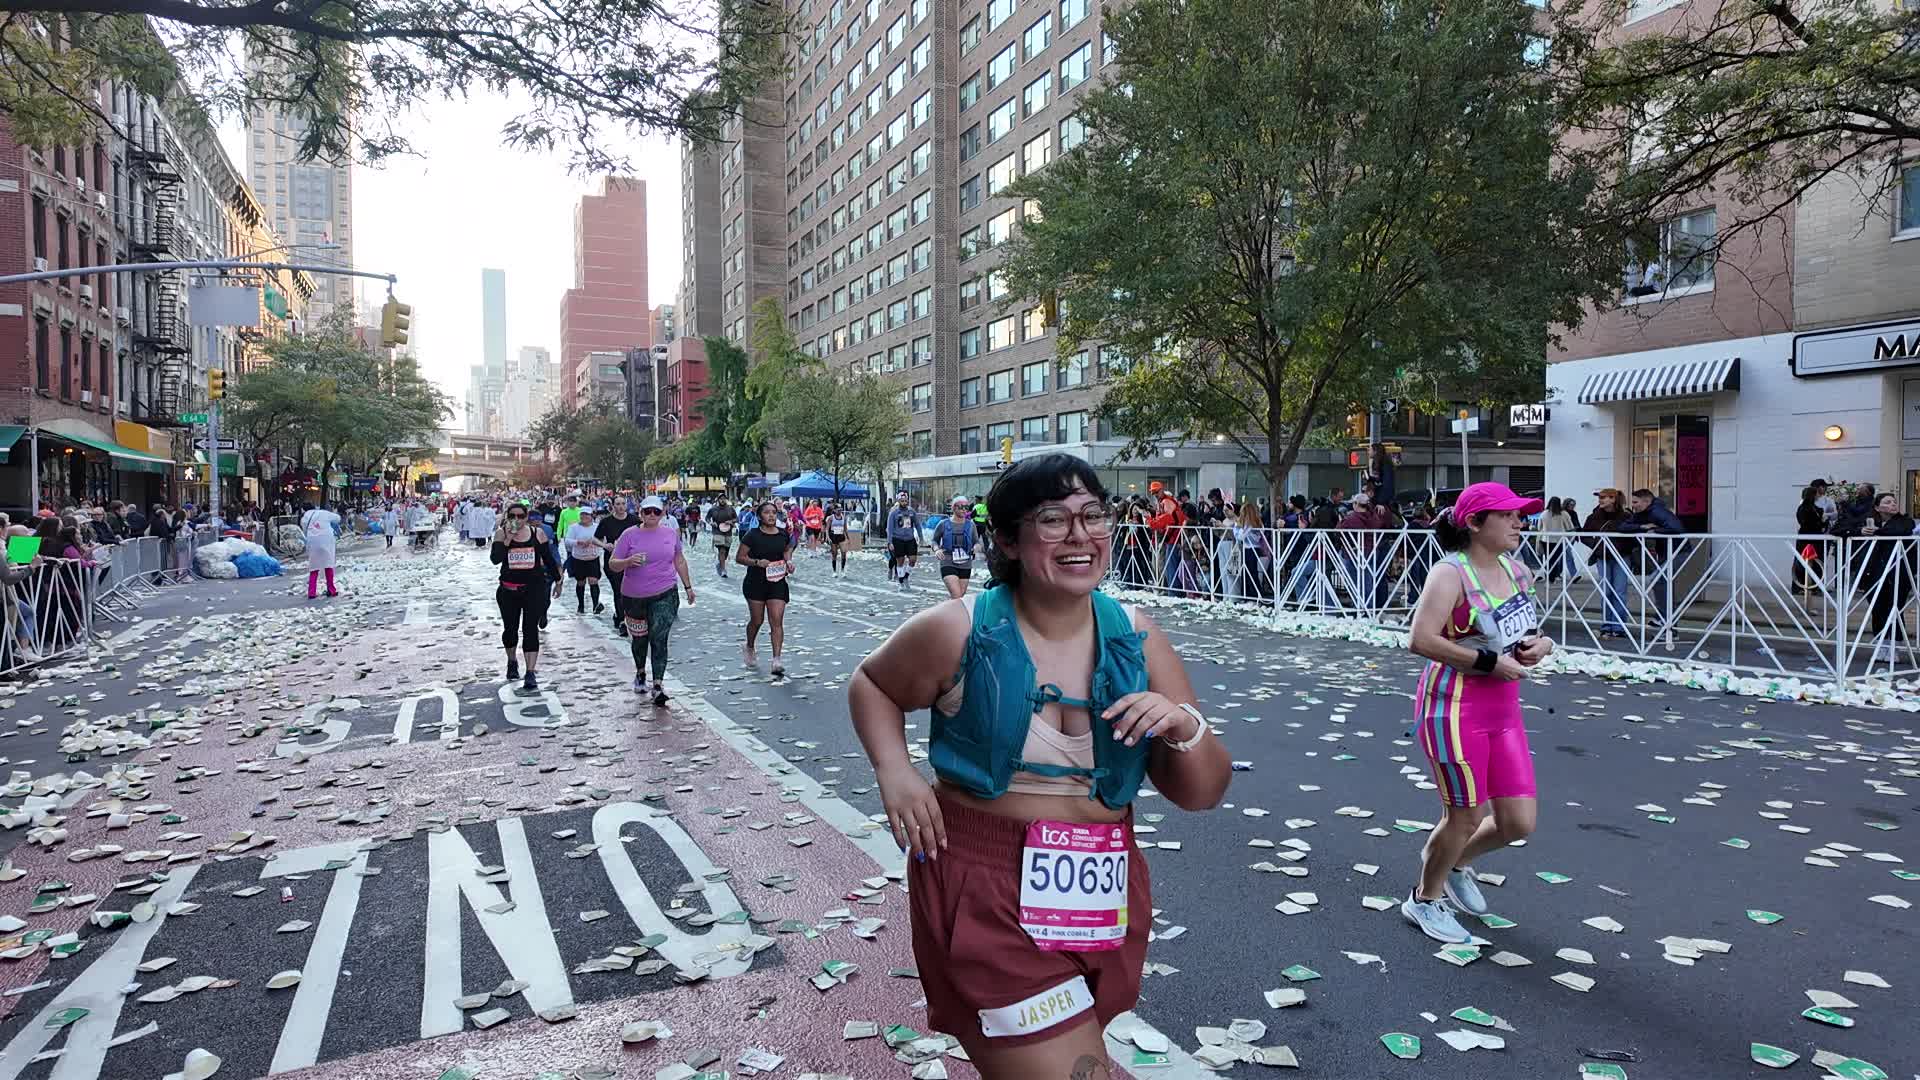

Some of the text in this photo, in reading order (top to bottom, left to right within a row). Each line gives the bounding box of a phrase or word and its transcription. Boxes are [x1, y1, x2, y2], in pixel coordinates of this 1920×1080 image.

[1503, 605, 1536, 638] 62776
[1042, 825, 1070, 846] tcs
[1029, 852, 1126, 895] 50630
[1041, 928, 1049, 937] 4
[1018, 989, 1076, 1028] JASPER
